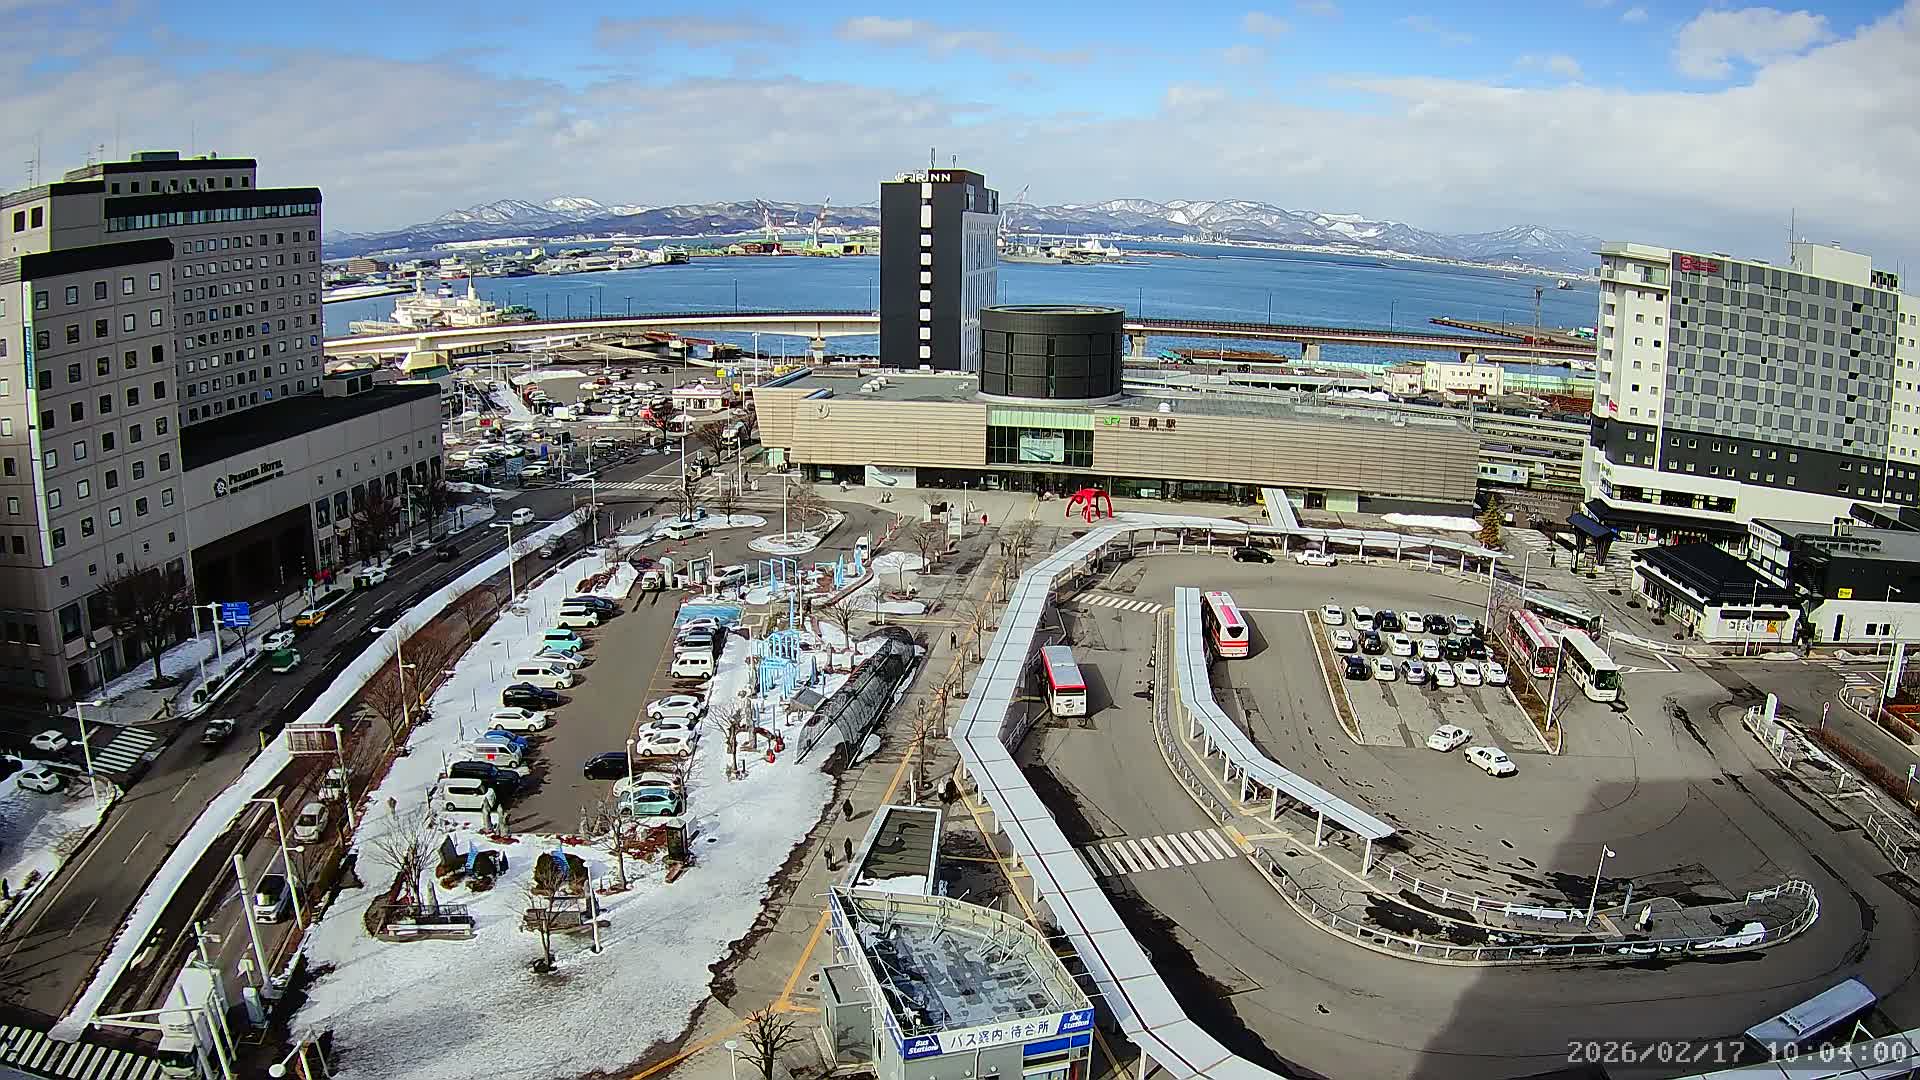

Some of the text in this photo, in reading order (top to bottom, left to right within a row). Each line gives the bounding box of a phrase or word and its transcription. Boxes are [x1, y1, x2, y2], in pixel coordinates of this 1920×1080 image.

[1104, 415, 1120, 425] JR
[1063, 1019, 1090, 1030] Station
[907, 1045, 939, 1054] Station
